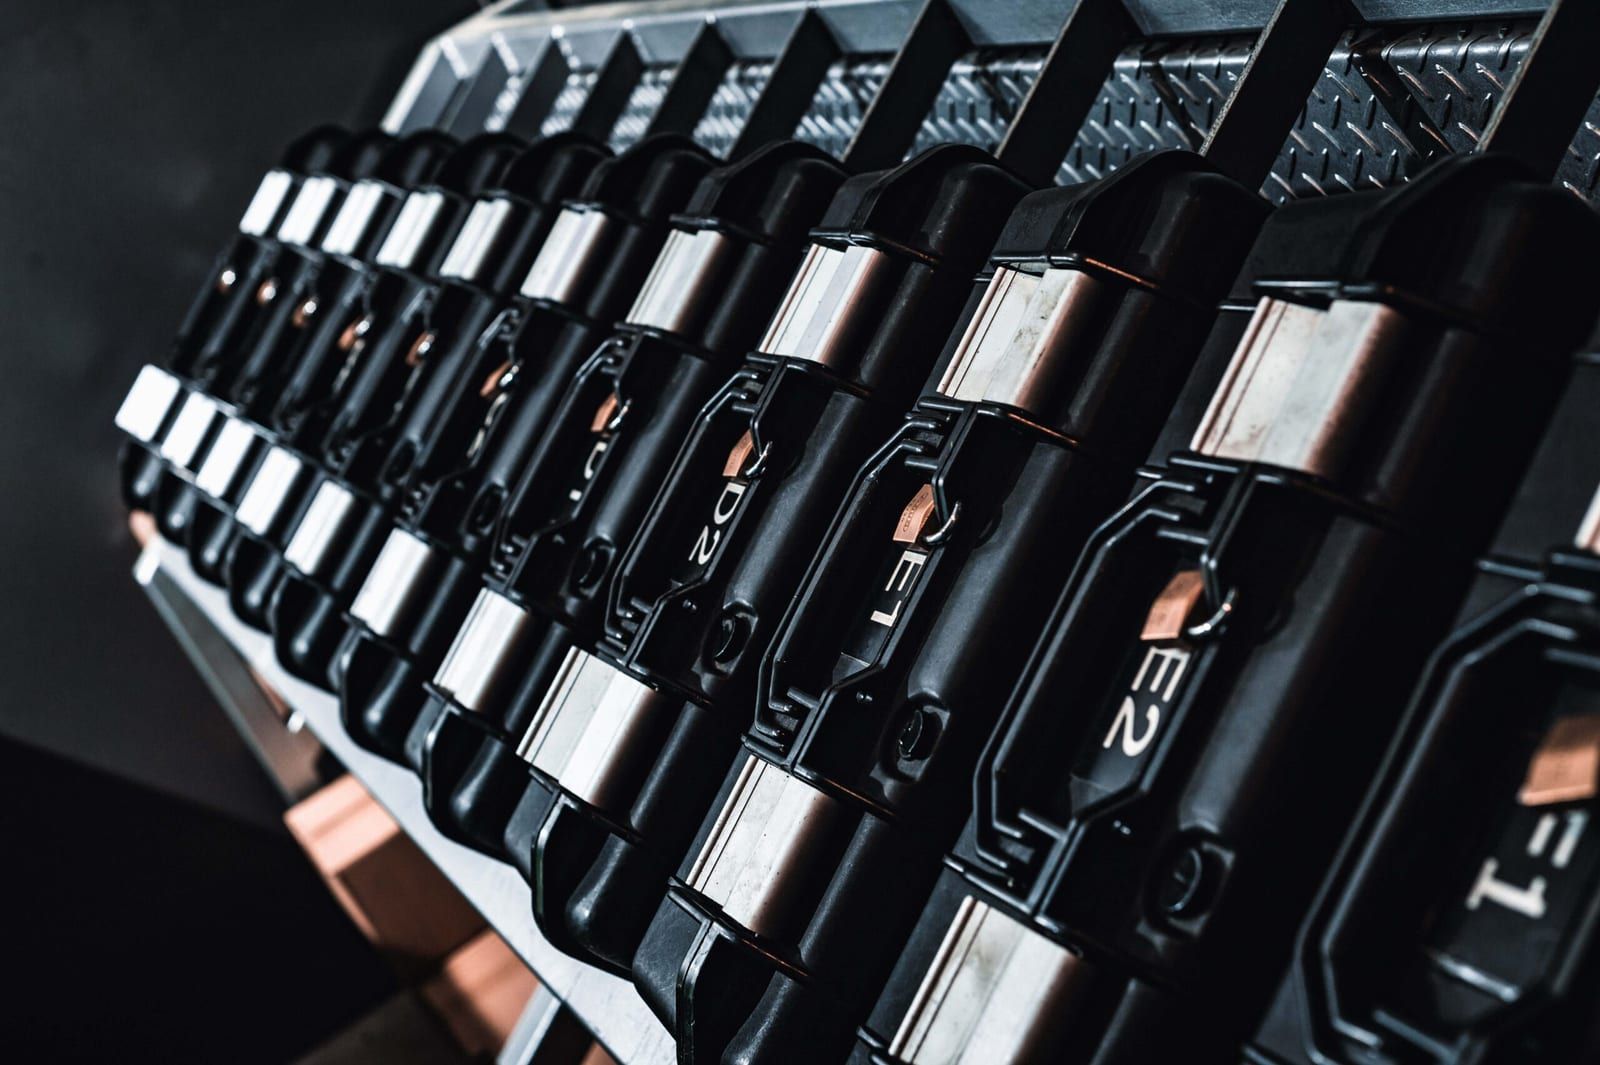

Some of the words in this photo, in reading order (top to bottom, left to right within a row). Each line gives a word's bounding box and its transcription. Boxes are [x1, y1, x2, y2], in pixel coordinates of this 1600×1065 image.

[688, 482, 747, 565] D2
[870, 550, 927, 627] E1
[1103, 646, 1190, 756] E2
